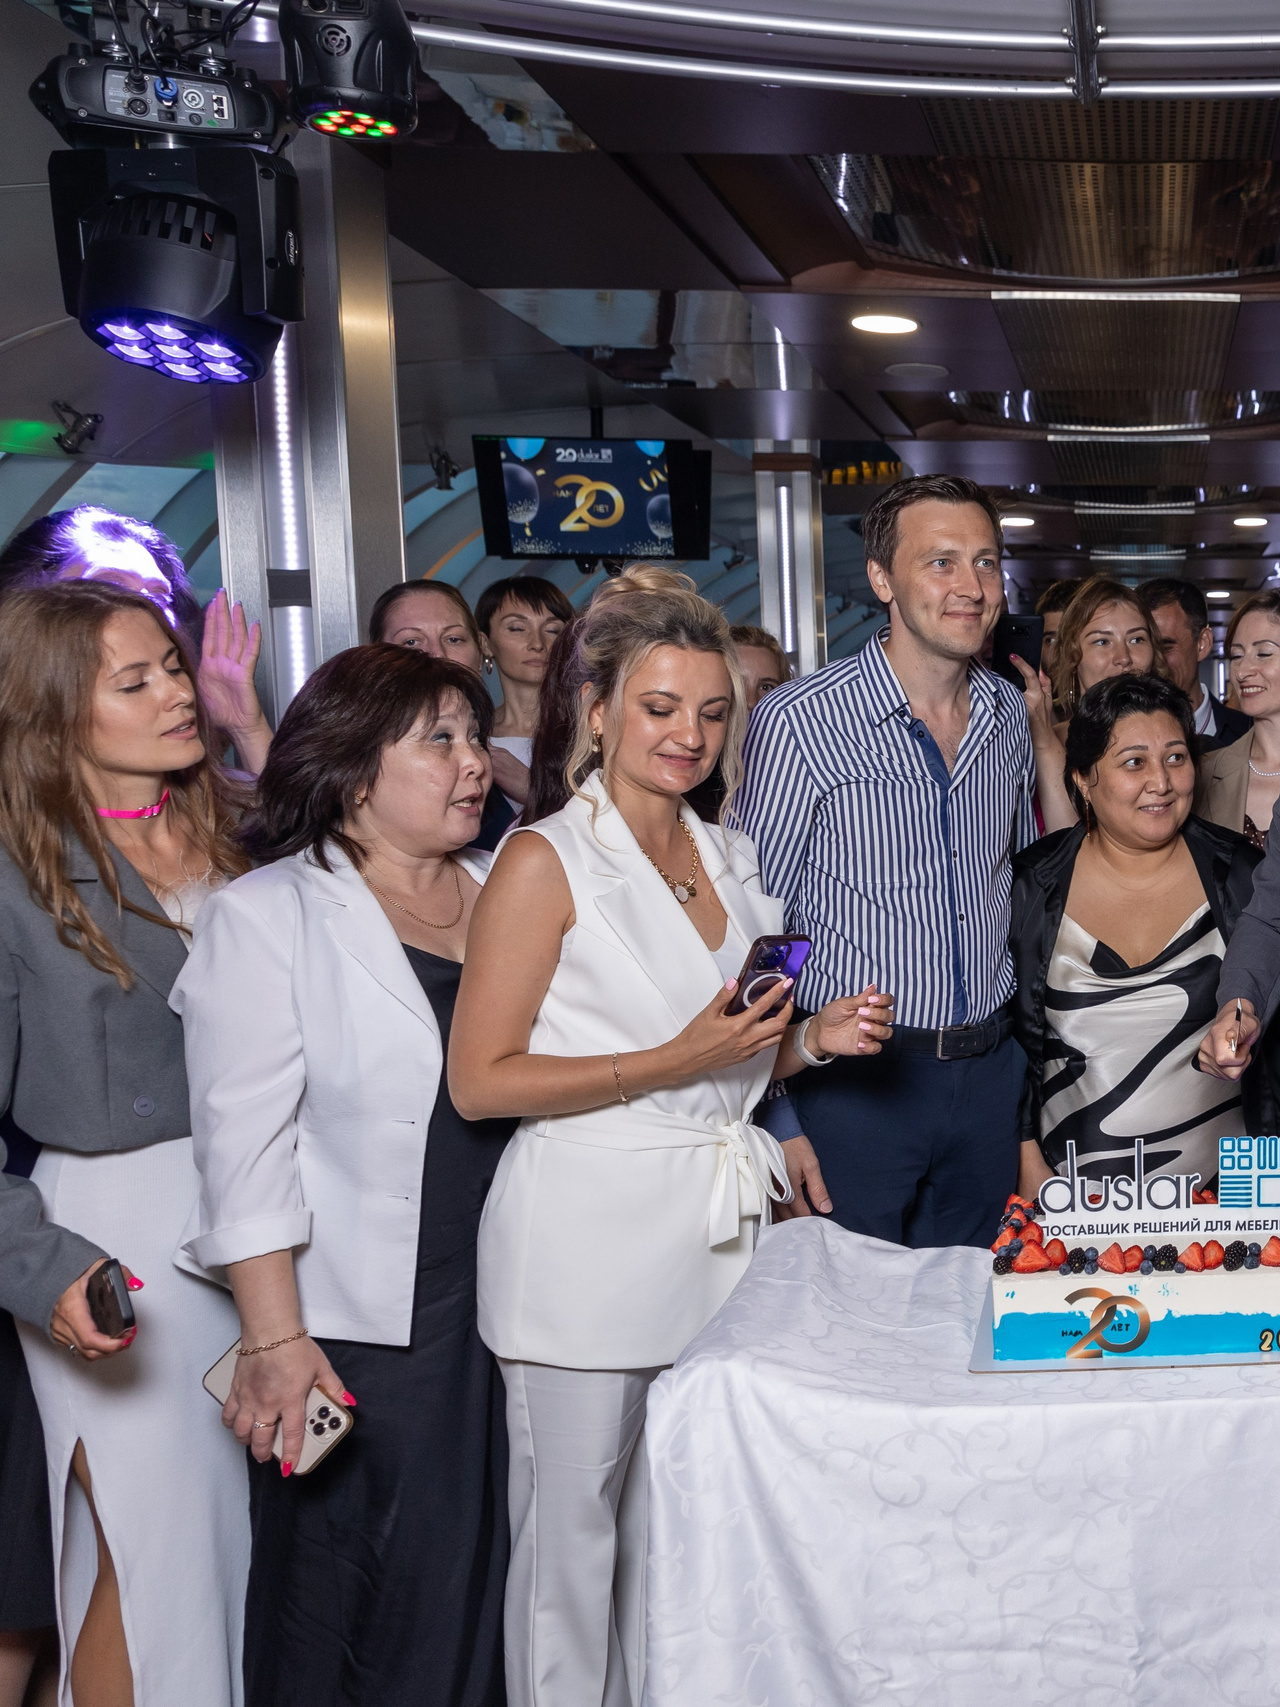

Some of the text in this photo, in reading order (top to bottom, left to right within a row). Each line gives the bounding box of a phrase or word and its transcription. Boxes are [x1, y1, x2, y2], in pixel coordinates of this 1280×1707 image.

[555, 448, 577, 463] 20
[554, 474, 625, 532] 20
[1040, 1140, 1200, 1212] duslar
[1042, 1223, 1130, 1237] ПОСТАВЩИК
[1133, 1218, 1202, 1234] РЕШЕНИЙ
[1203, 1220, 1231, 1233] ДЛЯ
[1061, 1287, 1151, 1359] НАМ 20 ЛЕТ
